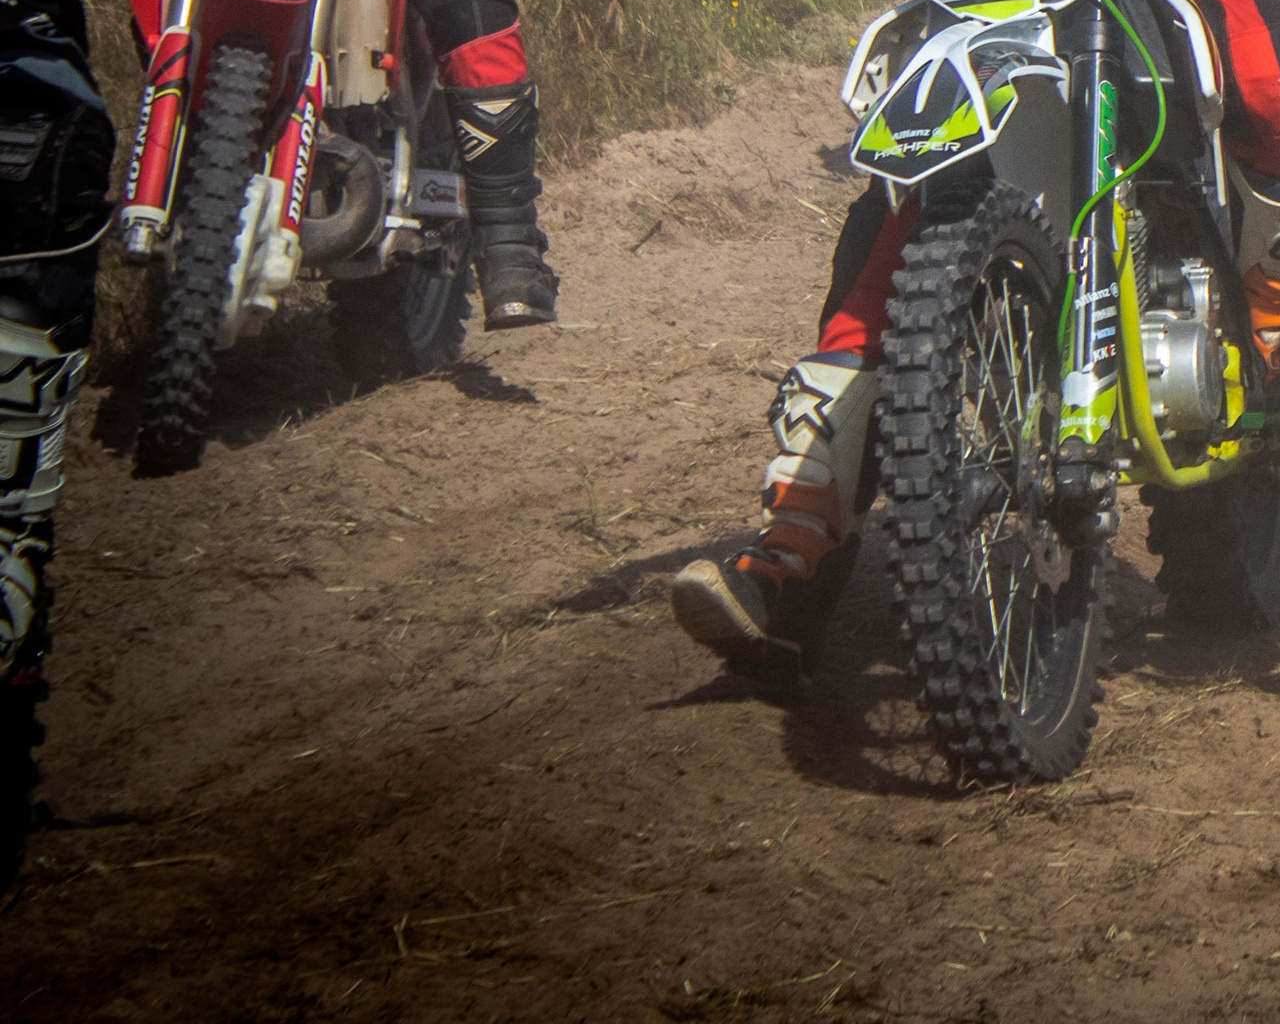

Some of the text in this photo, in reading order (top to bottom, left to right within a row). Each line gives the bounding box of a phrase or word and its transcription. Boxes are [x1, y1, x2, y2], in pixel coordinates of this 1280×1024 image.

[890, 127, 931, 141] Allianz
[873, 140, 963, 161] HIGHPER
[288, 101, 316, 226] DUNLOP
